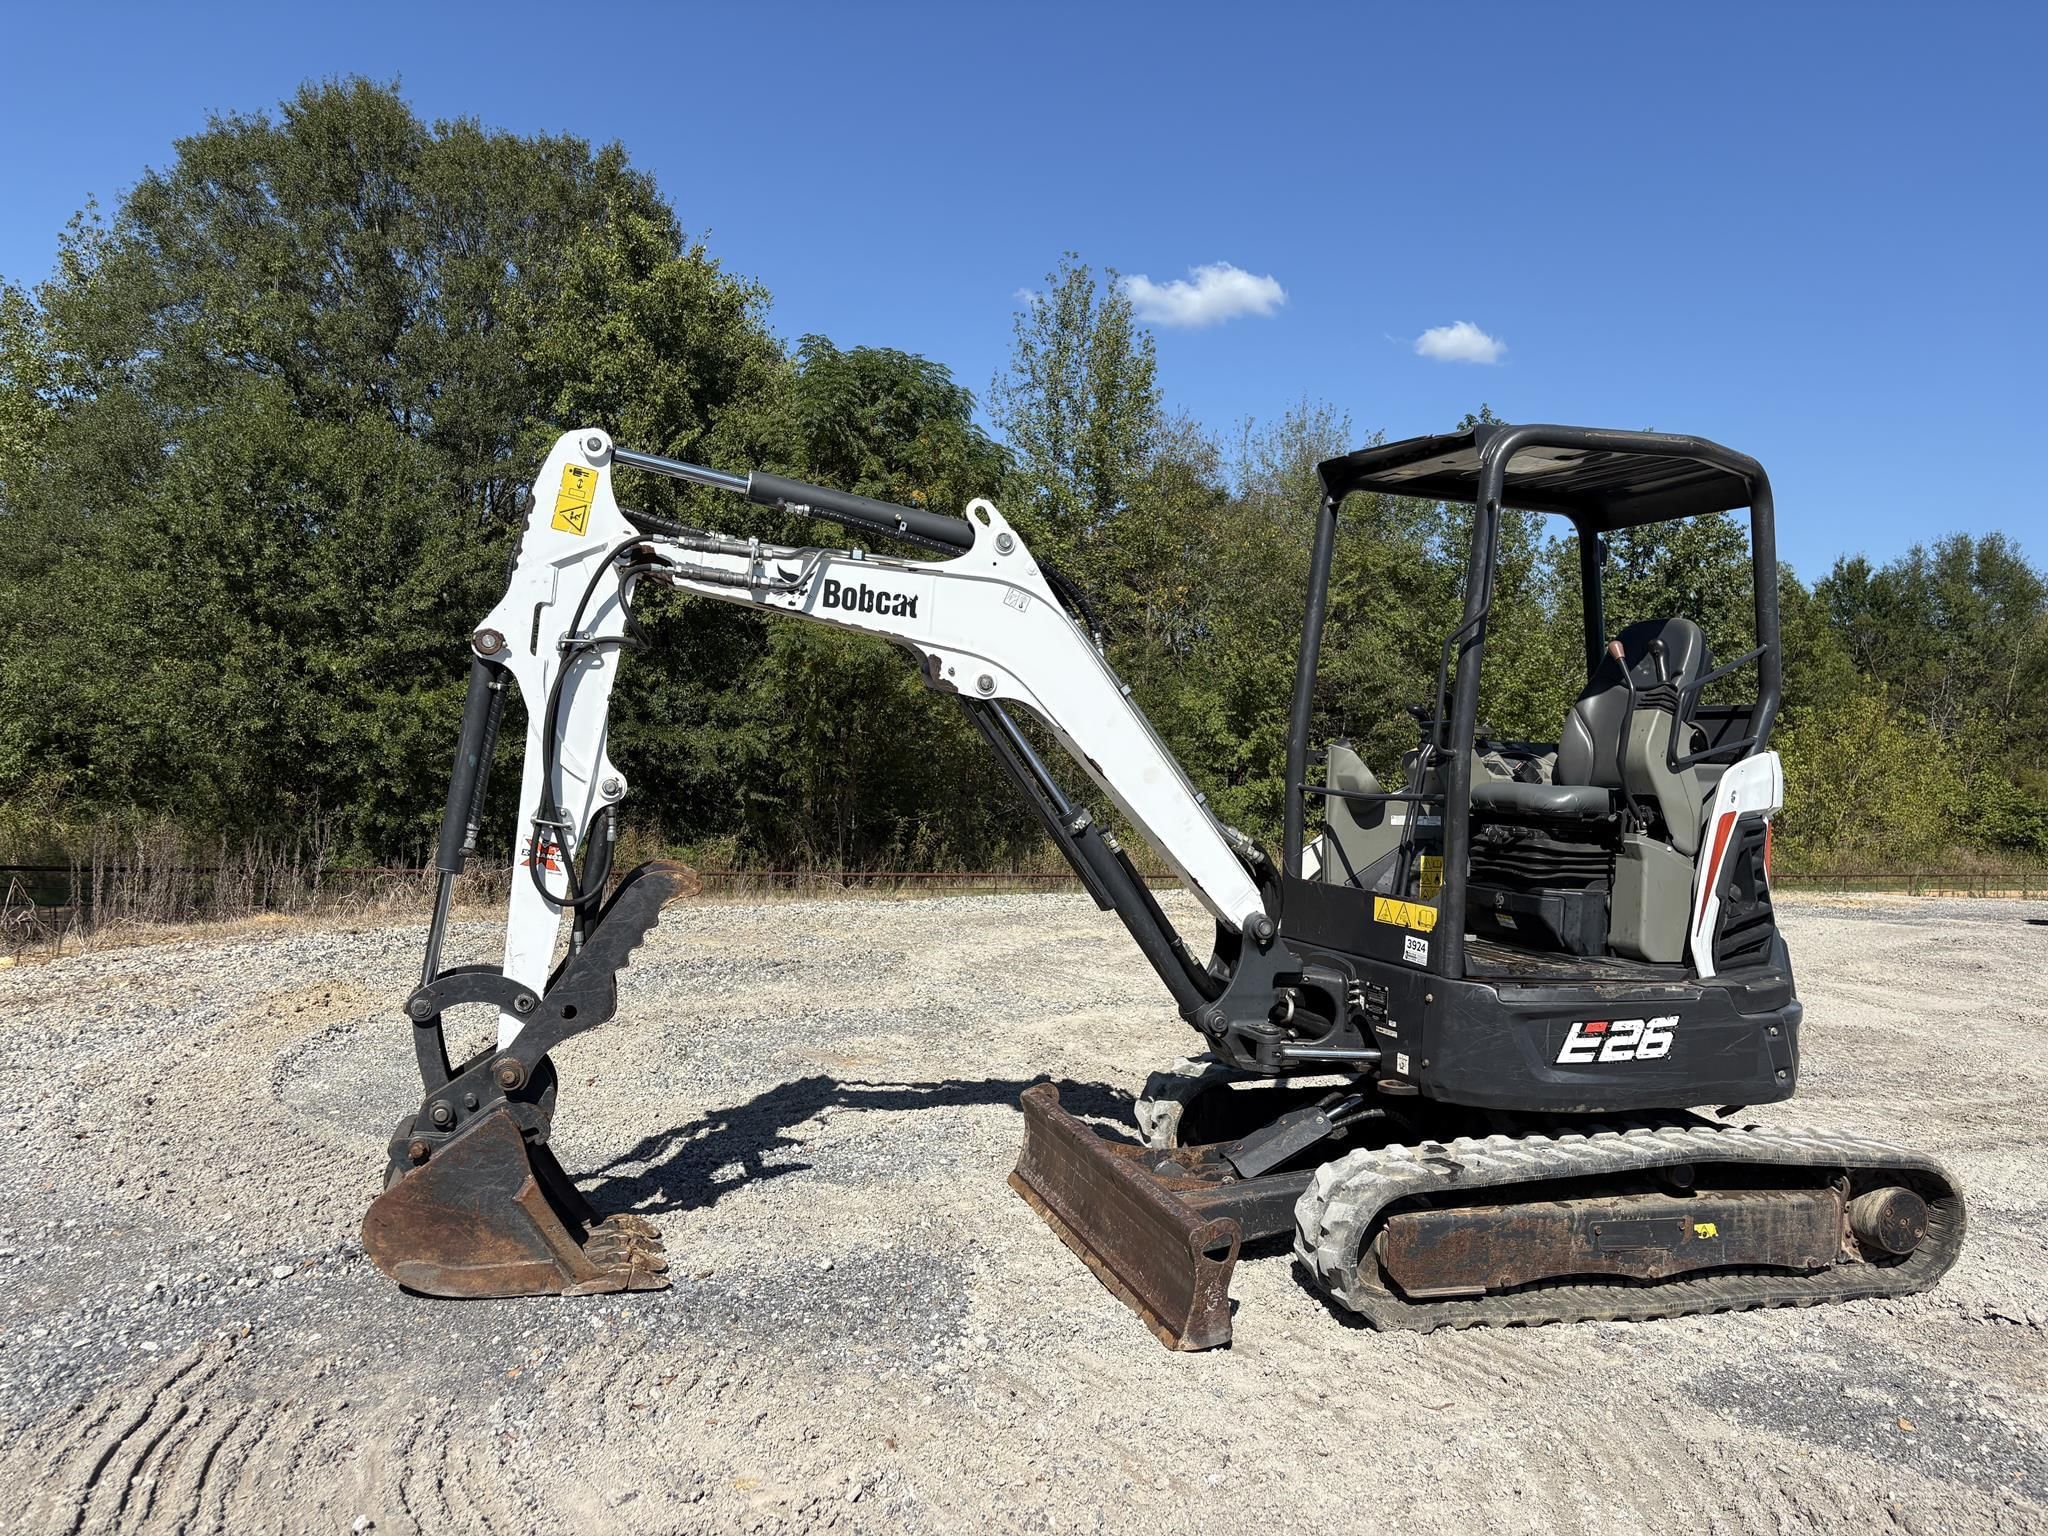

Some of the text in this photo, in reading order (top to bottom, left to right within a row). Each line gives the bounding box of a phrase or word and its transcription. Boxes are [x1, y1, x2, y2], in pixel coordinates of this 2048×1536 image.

[822, 578, 918, 618] Bobcat
[1406, 938, 1426, 953] 3924
[1555, 1015, 1680, 1064] E26
